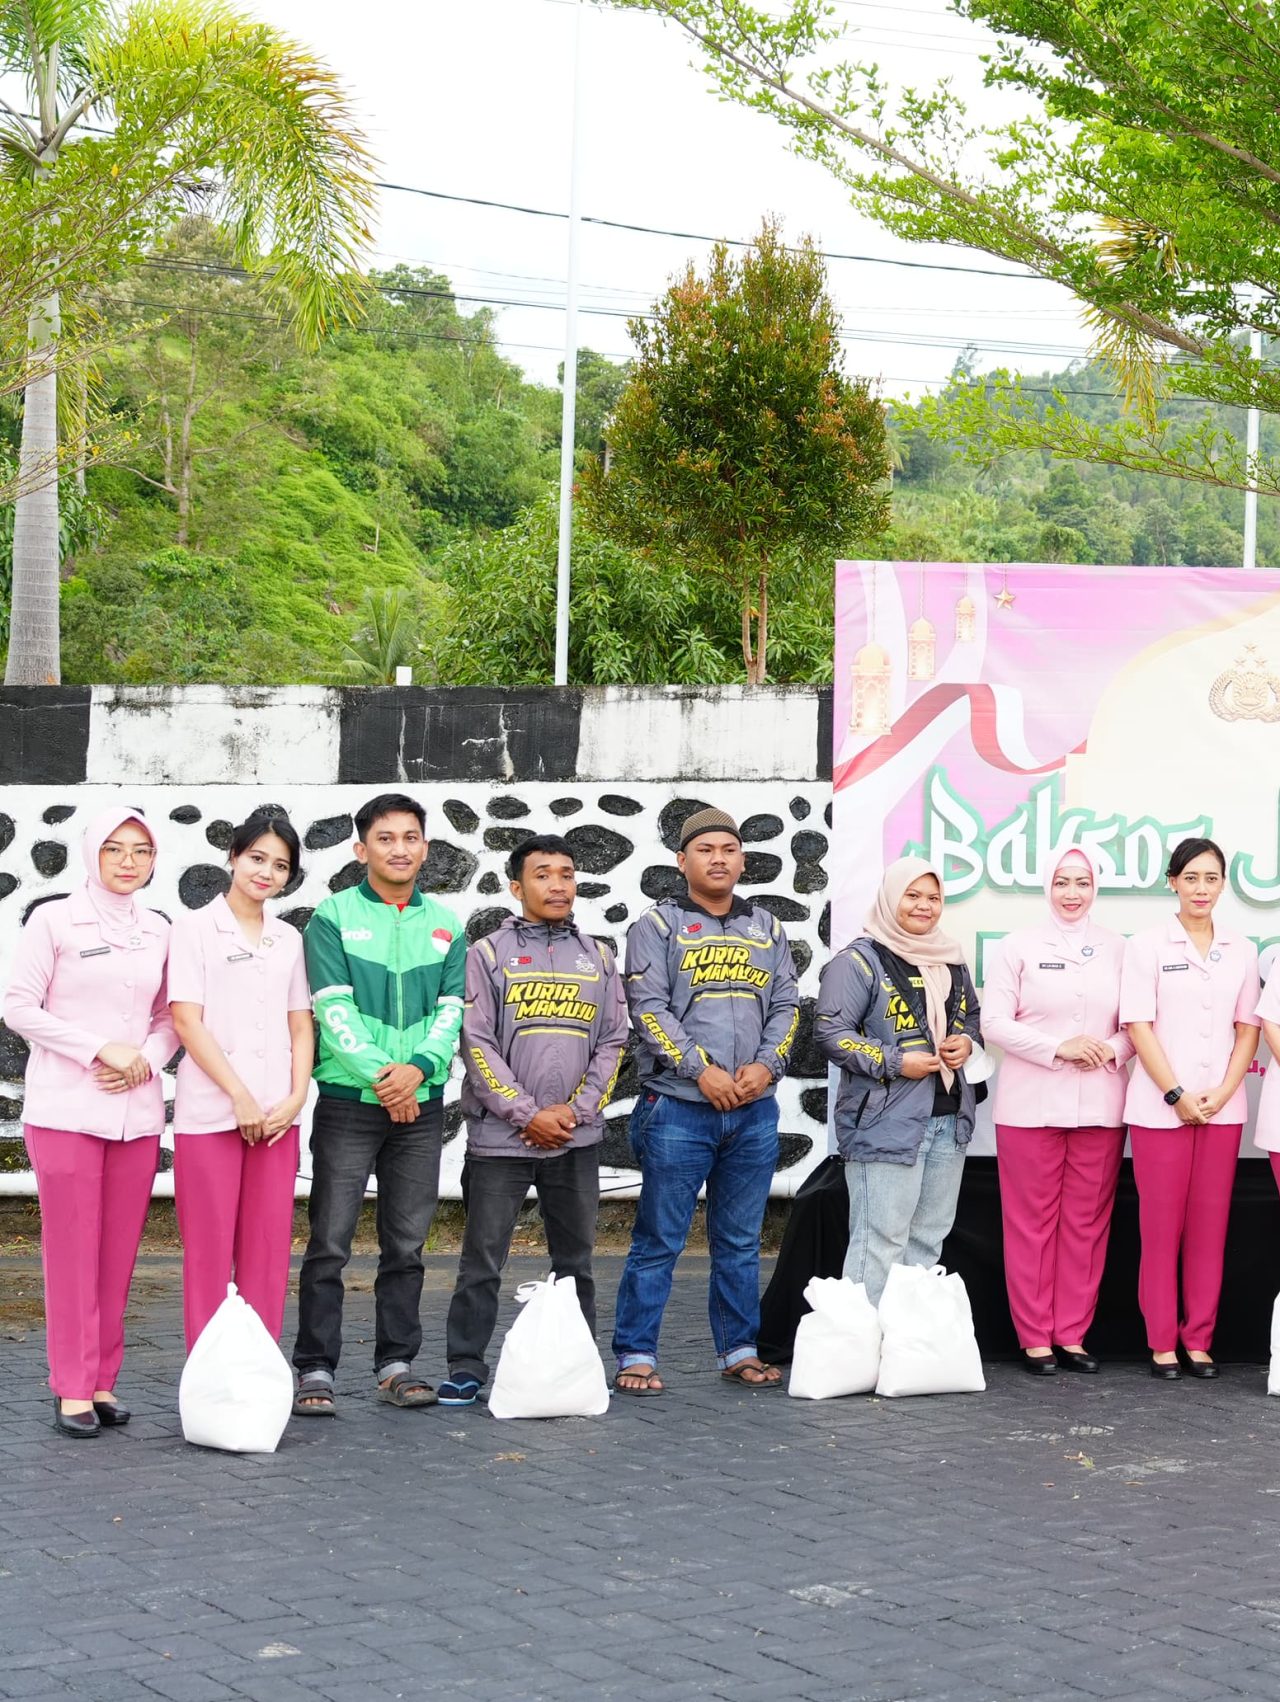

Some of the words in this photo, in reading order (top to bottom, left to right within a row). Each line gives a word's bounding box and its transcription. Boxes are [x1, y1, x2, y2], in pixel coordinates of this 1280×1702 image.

[681, 945, 750, 970] KURIR
[690, 964, 771, 988] MAMUJU
[505, 982, 581, 1005] KURIR
[515, 1000, 597, 1023] MAMUJU
